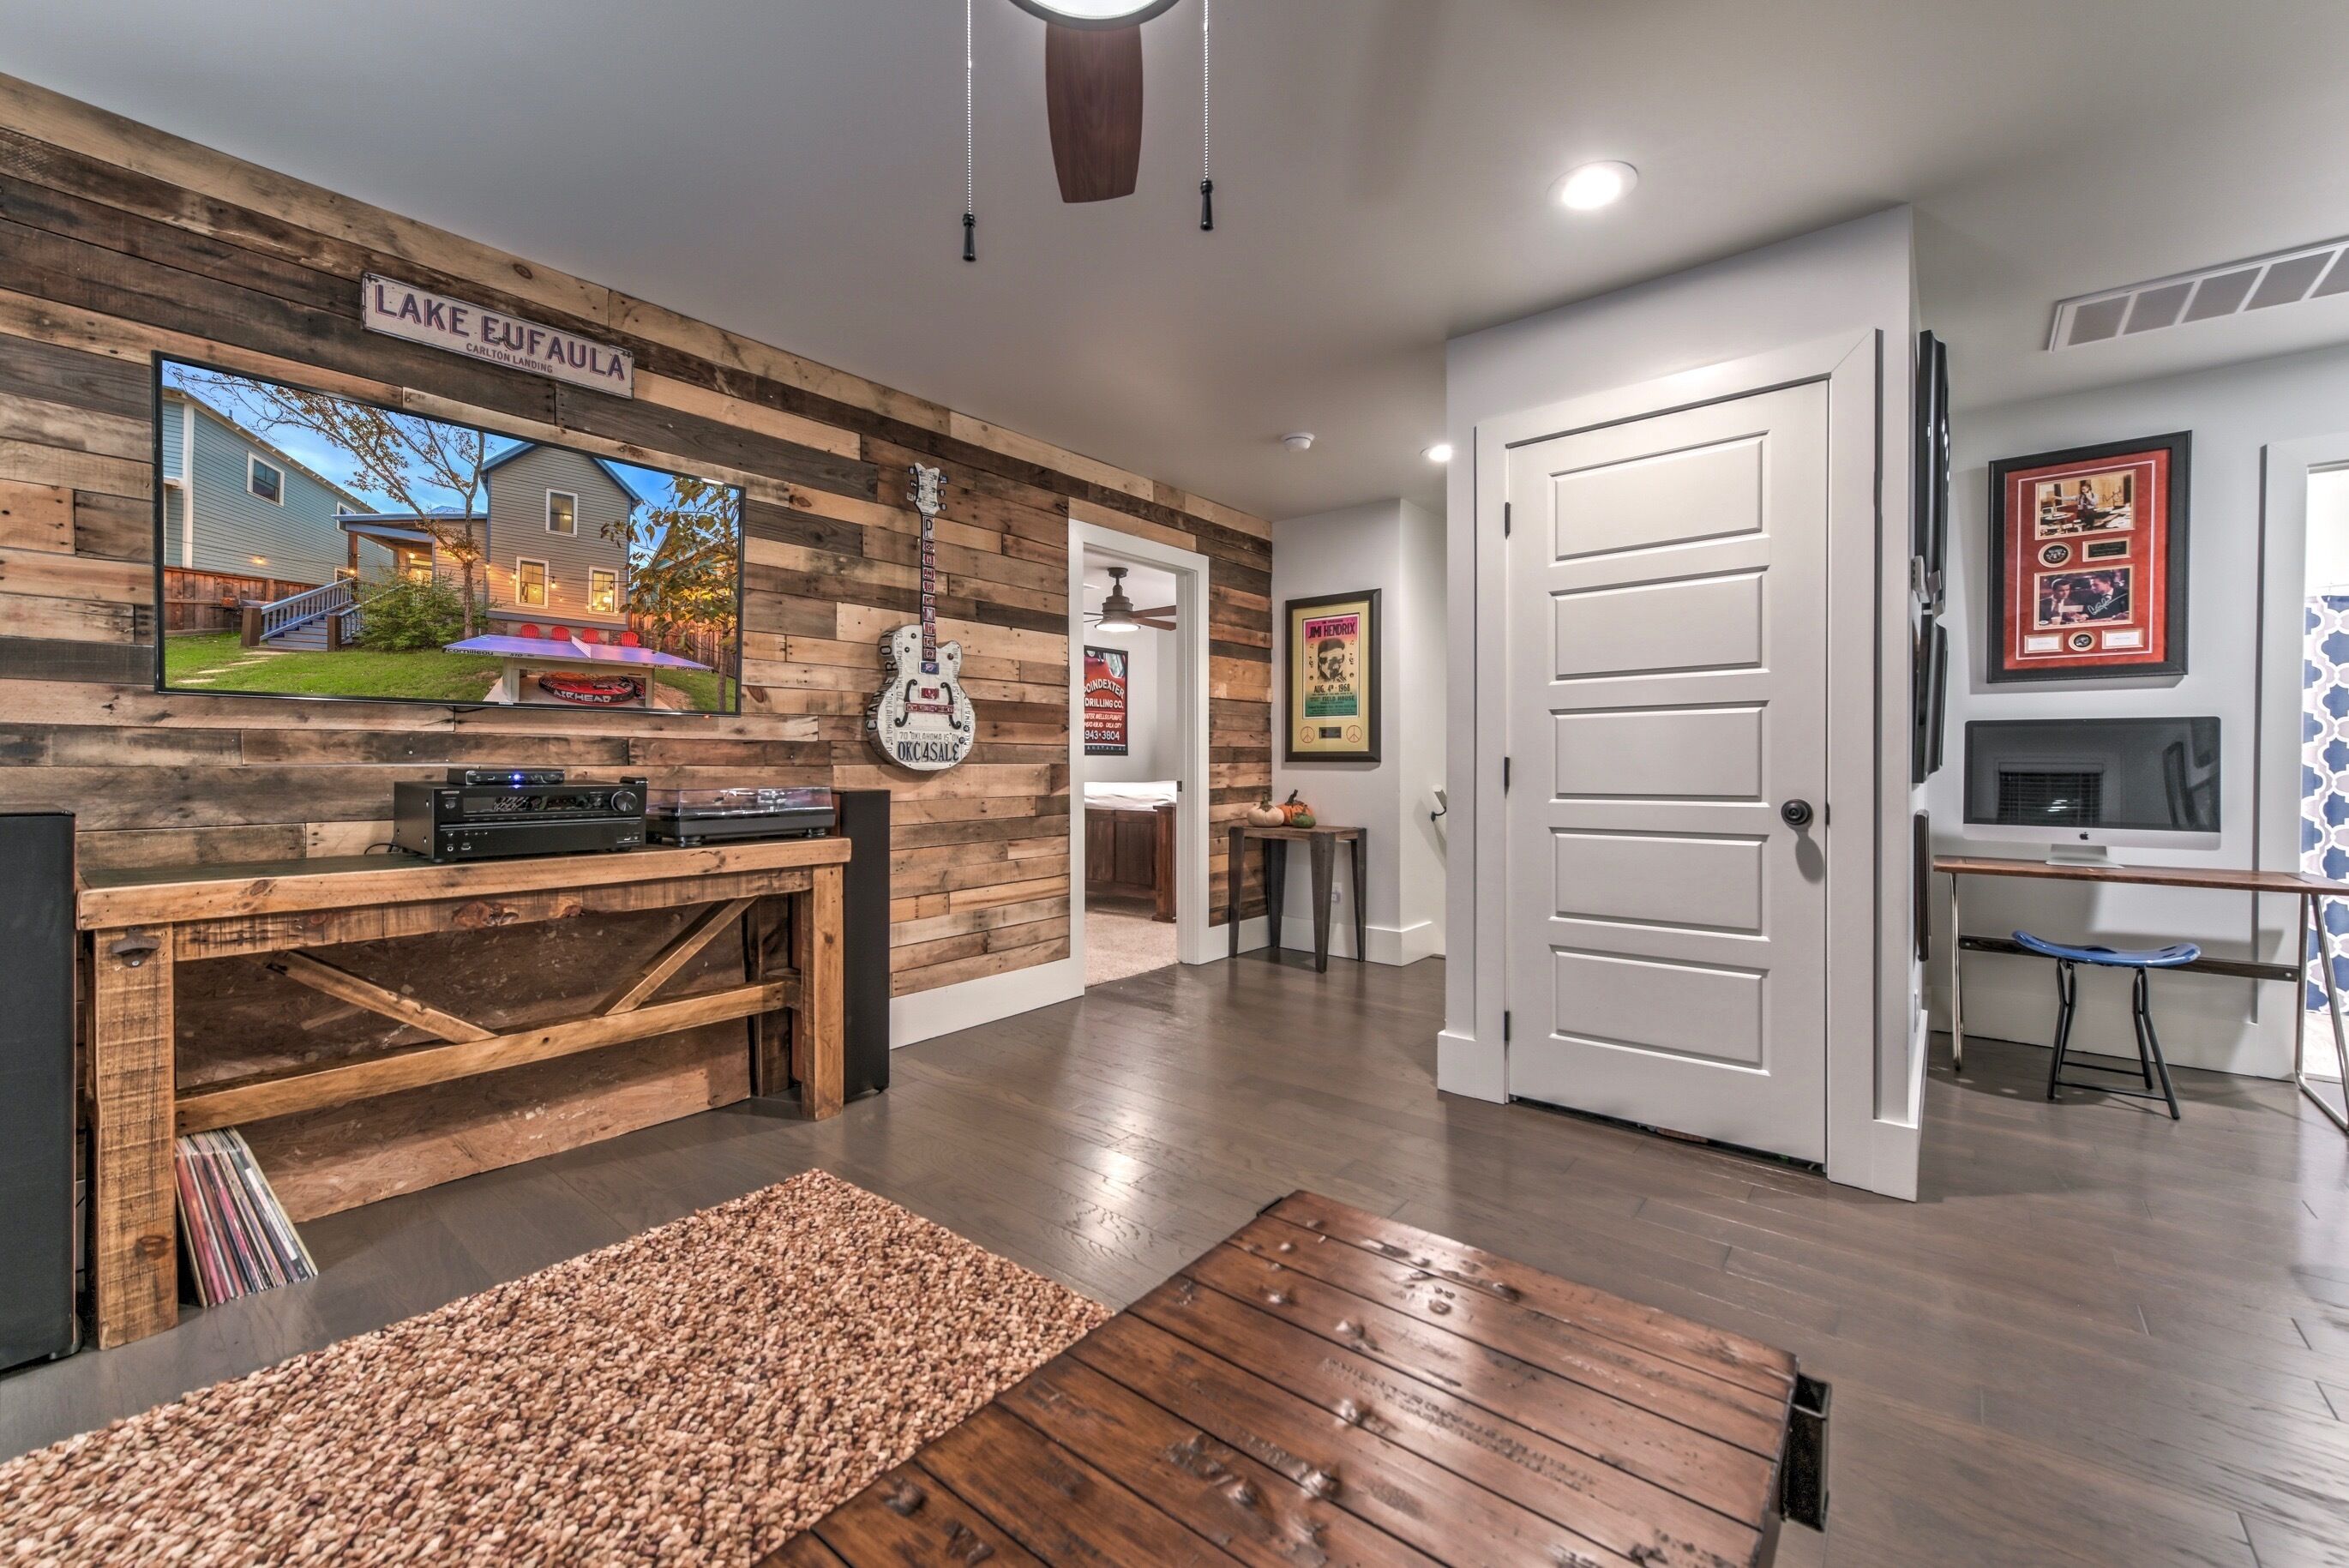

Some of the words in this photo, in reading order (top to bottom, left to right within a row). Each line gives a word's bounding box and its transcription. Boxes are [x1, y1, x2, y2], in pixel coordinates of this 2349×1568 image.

[375, 284, 470, 338] LAKE
[481, 315, 625, 381] EUFAULA
[466, 343, 510, 363] CARLTON
[512, 354, 553, 374] LANDING
[1308, 625, 1322, 639] JIMI
[1324, 622, 1355, 637] HENDRIX
[1338, 683, 1350, 692] 1968
[554, 689, 612, 703] AIRHEAD
[1084, 698, 1114, 708] DRILLING
[1114, 700, 1124, 709] CO.
